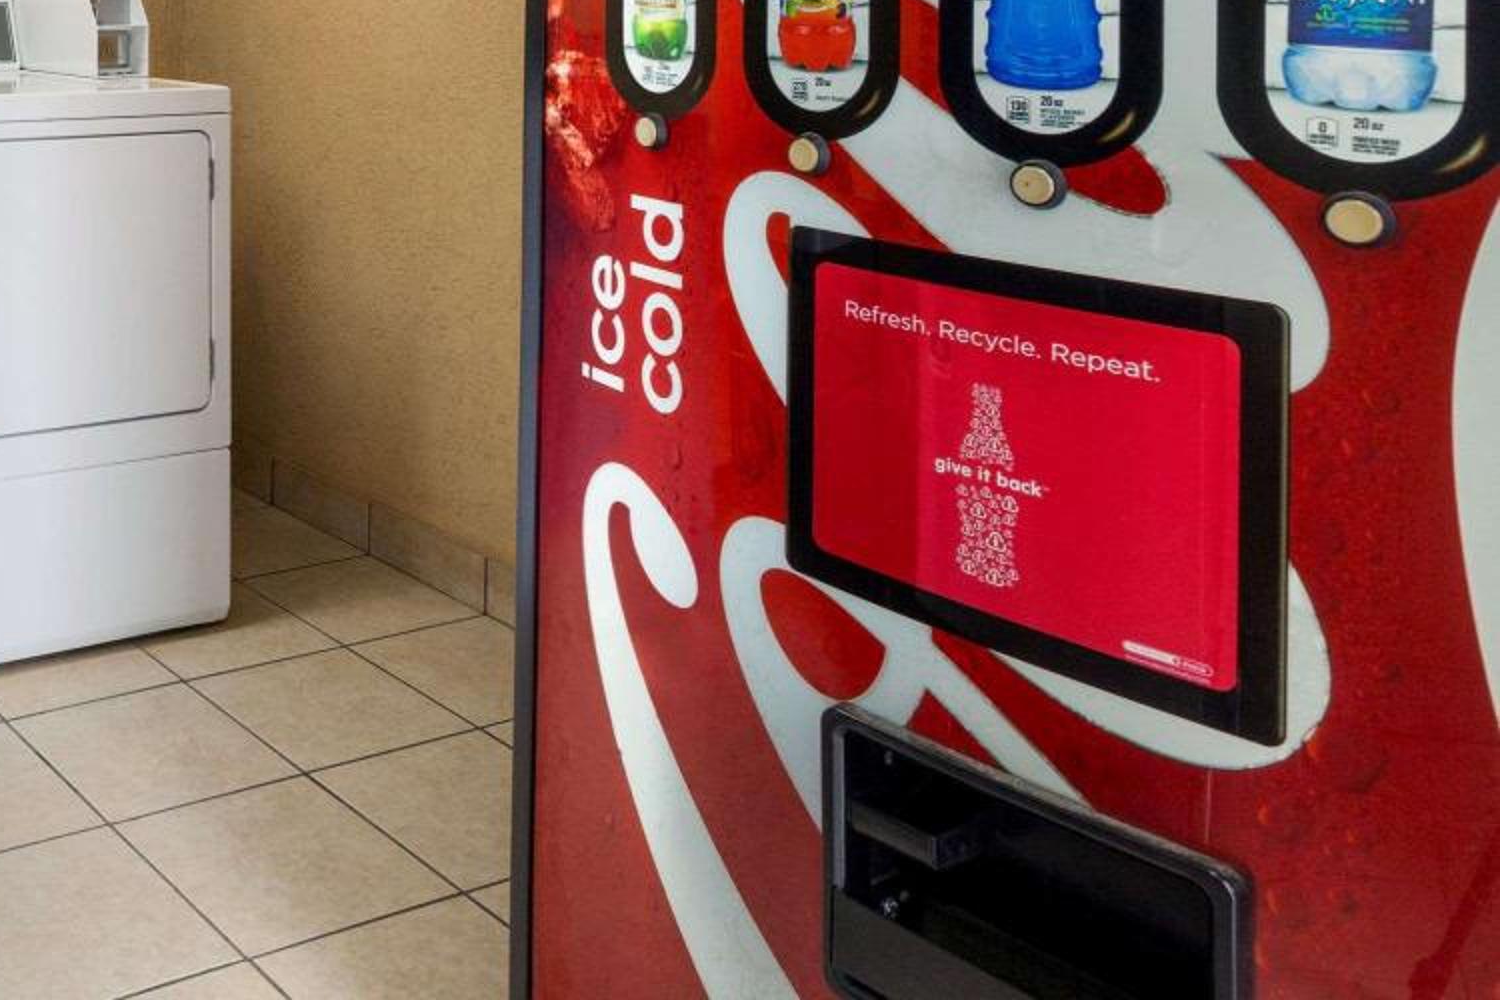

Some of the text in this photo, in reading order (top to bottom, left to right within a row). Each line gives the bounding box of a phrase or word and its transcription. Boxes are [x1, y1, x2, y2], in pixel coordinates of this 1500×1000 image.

[580, 254, 626, 393] ice
[630, 193, 685, 415] cold
[844, 299, 1162, 383] Refresh. Recycle. Repeat.
[934, 456, 973, 478] give
[977, 464, 991, 483] it
